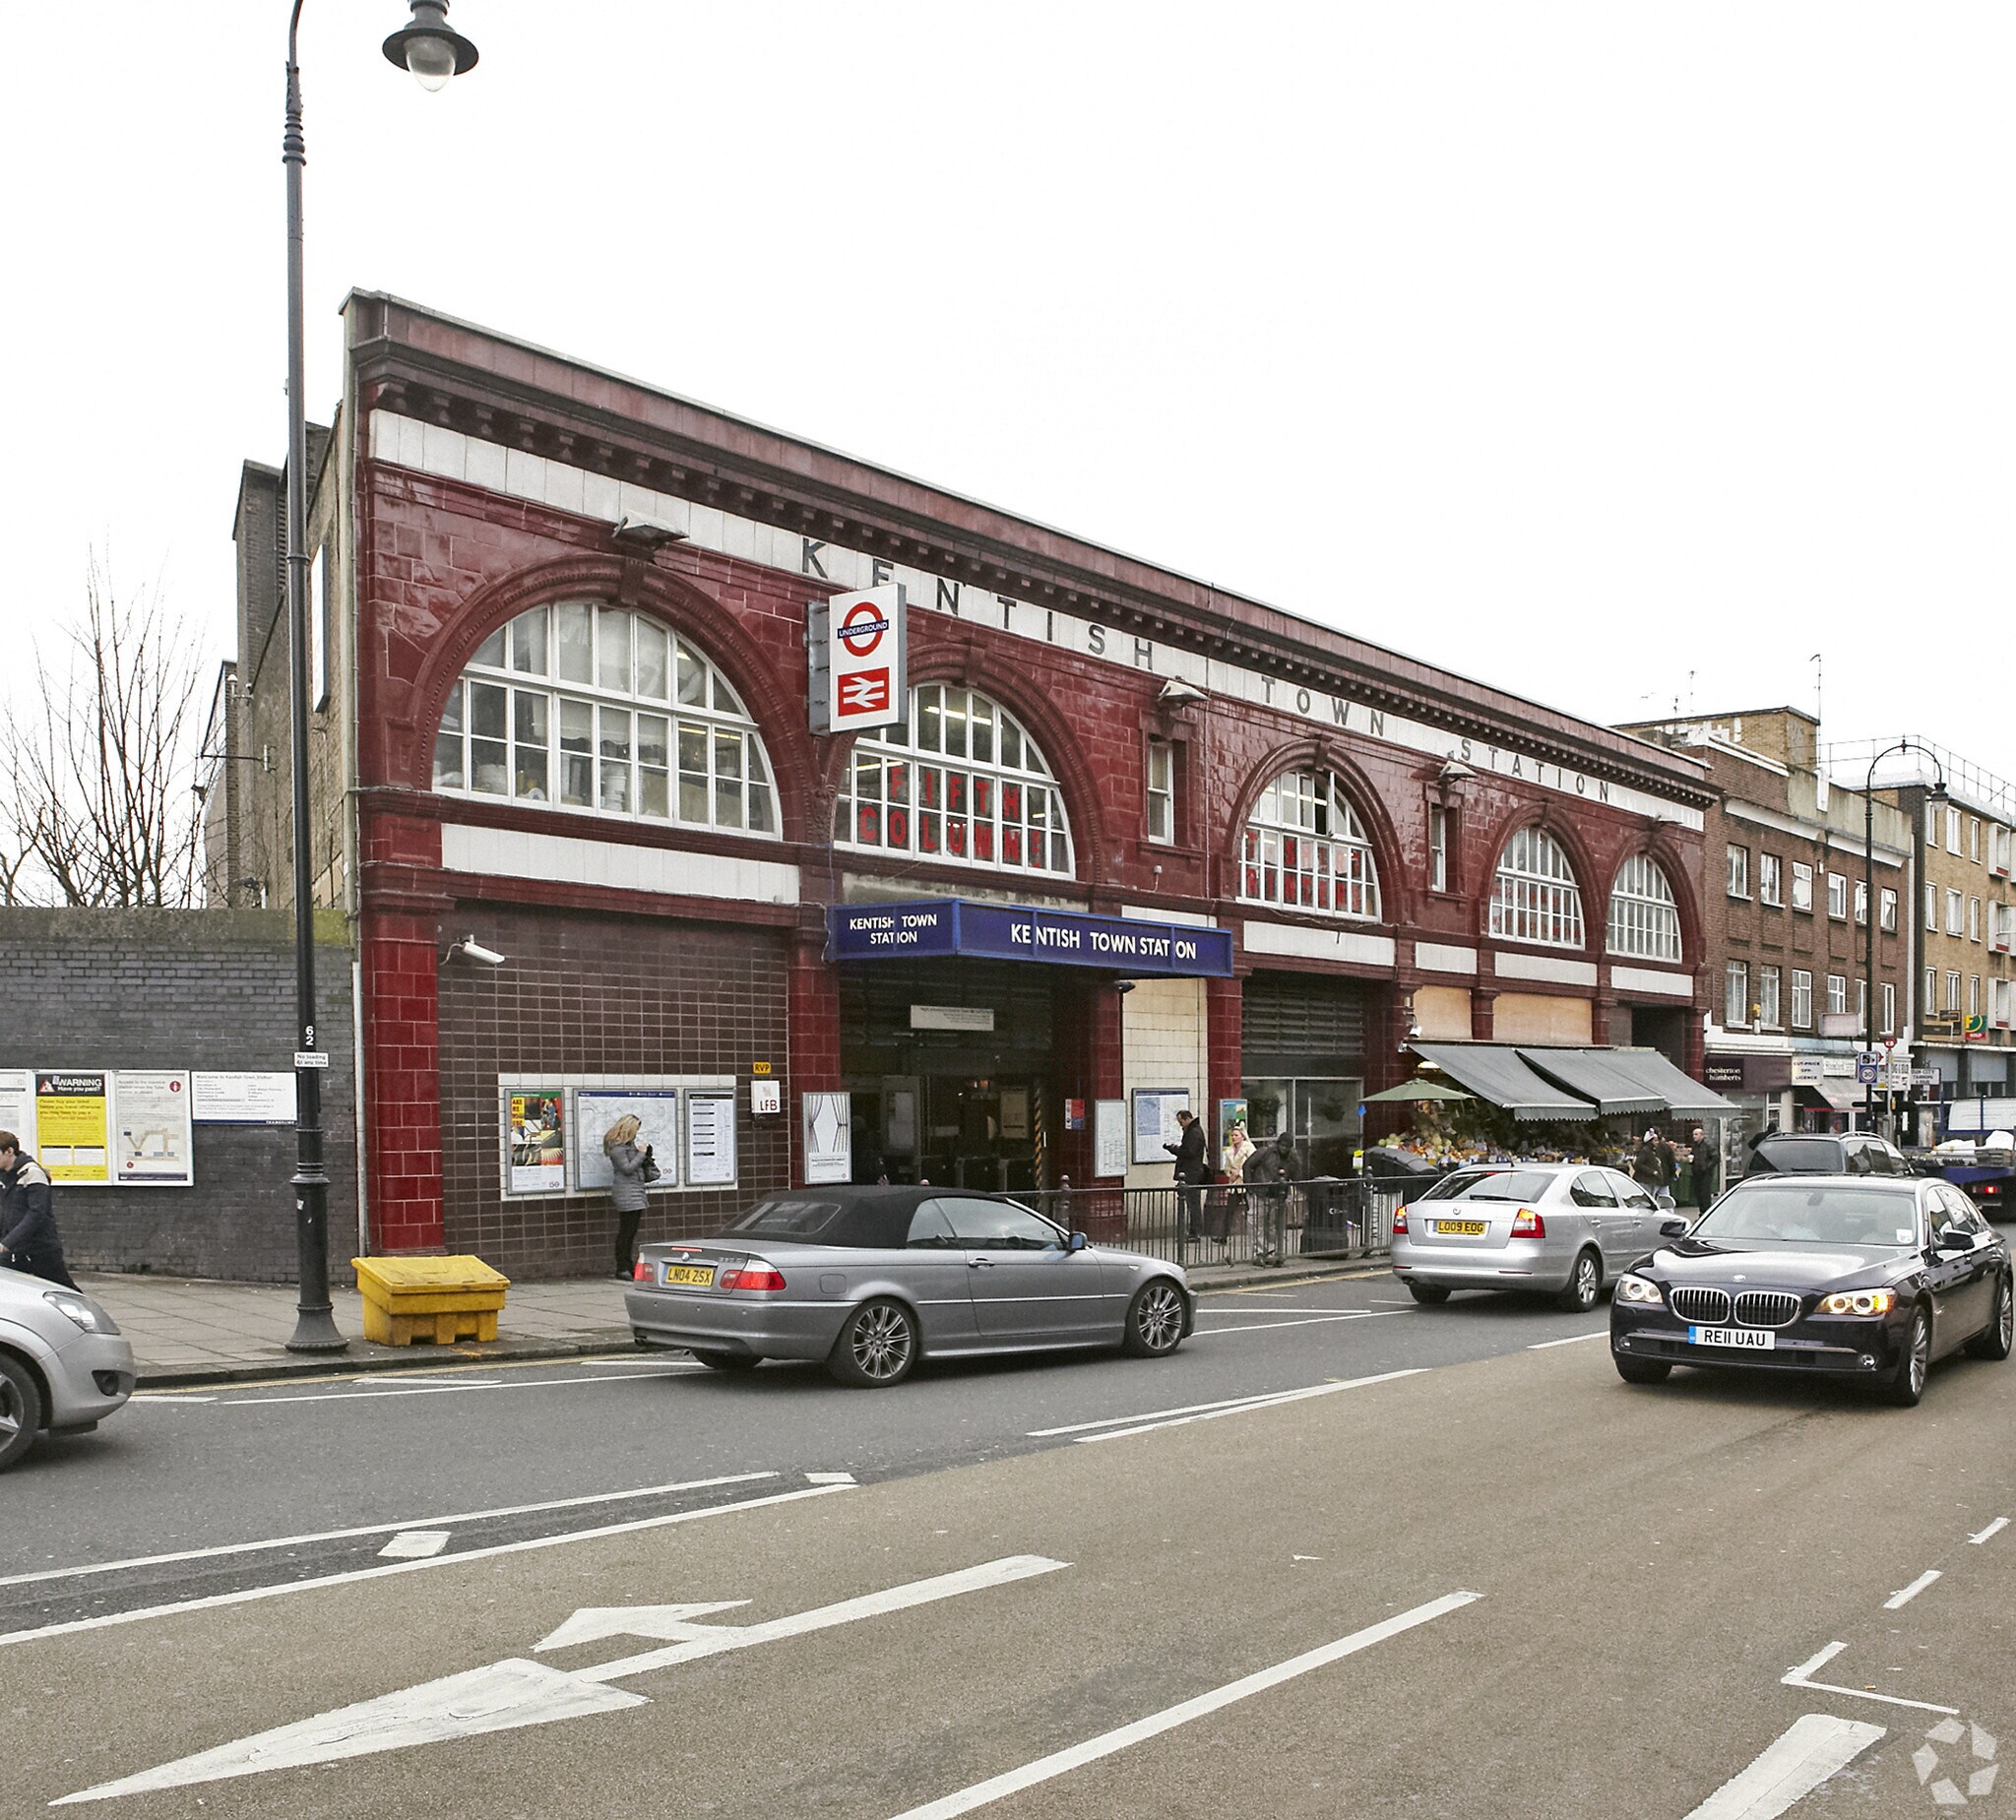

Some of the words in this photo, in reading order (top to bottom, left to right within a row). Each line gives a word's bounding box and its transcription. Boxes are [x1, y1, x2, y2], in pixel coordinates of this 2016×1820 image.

[839, 622, 888, 637] UNDERGROUND
[802, 537, 1153, 670] KENTISH
[1261, 676, 1384, 737] TOWN
[1460, 738, 1608, 803] STATION
[891, 766, 1019, 819] FIFTH
[850, 915, 895, 931] KENTISH
[902, 913, 938, 928] TOWN
[870, 931, 917, 945] STATION
[1011, 923, 1080, 949] KENTISH
[1090, 931, 1136, 955] TOWN
[1139, 937, 1197, 960] STATON
[754, 1064, 770, 1073] RVP
[59, 1078, 102, 1087] WARNING
[760, 1100, 778, 1111] LFB
[667, 1267, 689, 1281] LN04
[692, 1269, 712, 1284] ZSX
[1704, 1330, 1731, 1344] RE11
[1735, 1332, 1766, 1347] UAU
